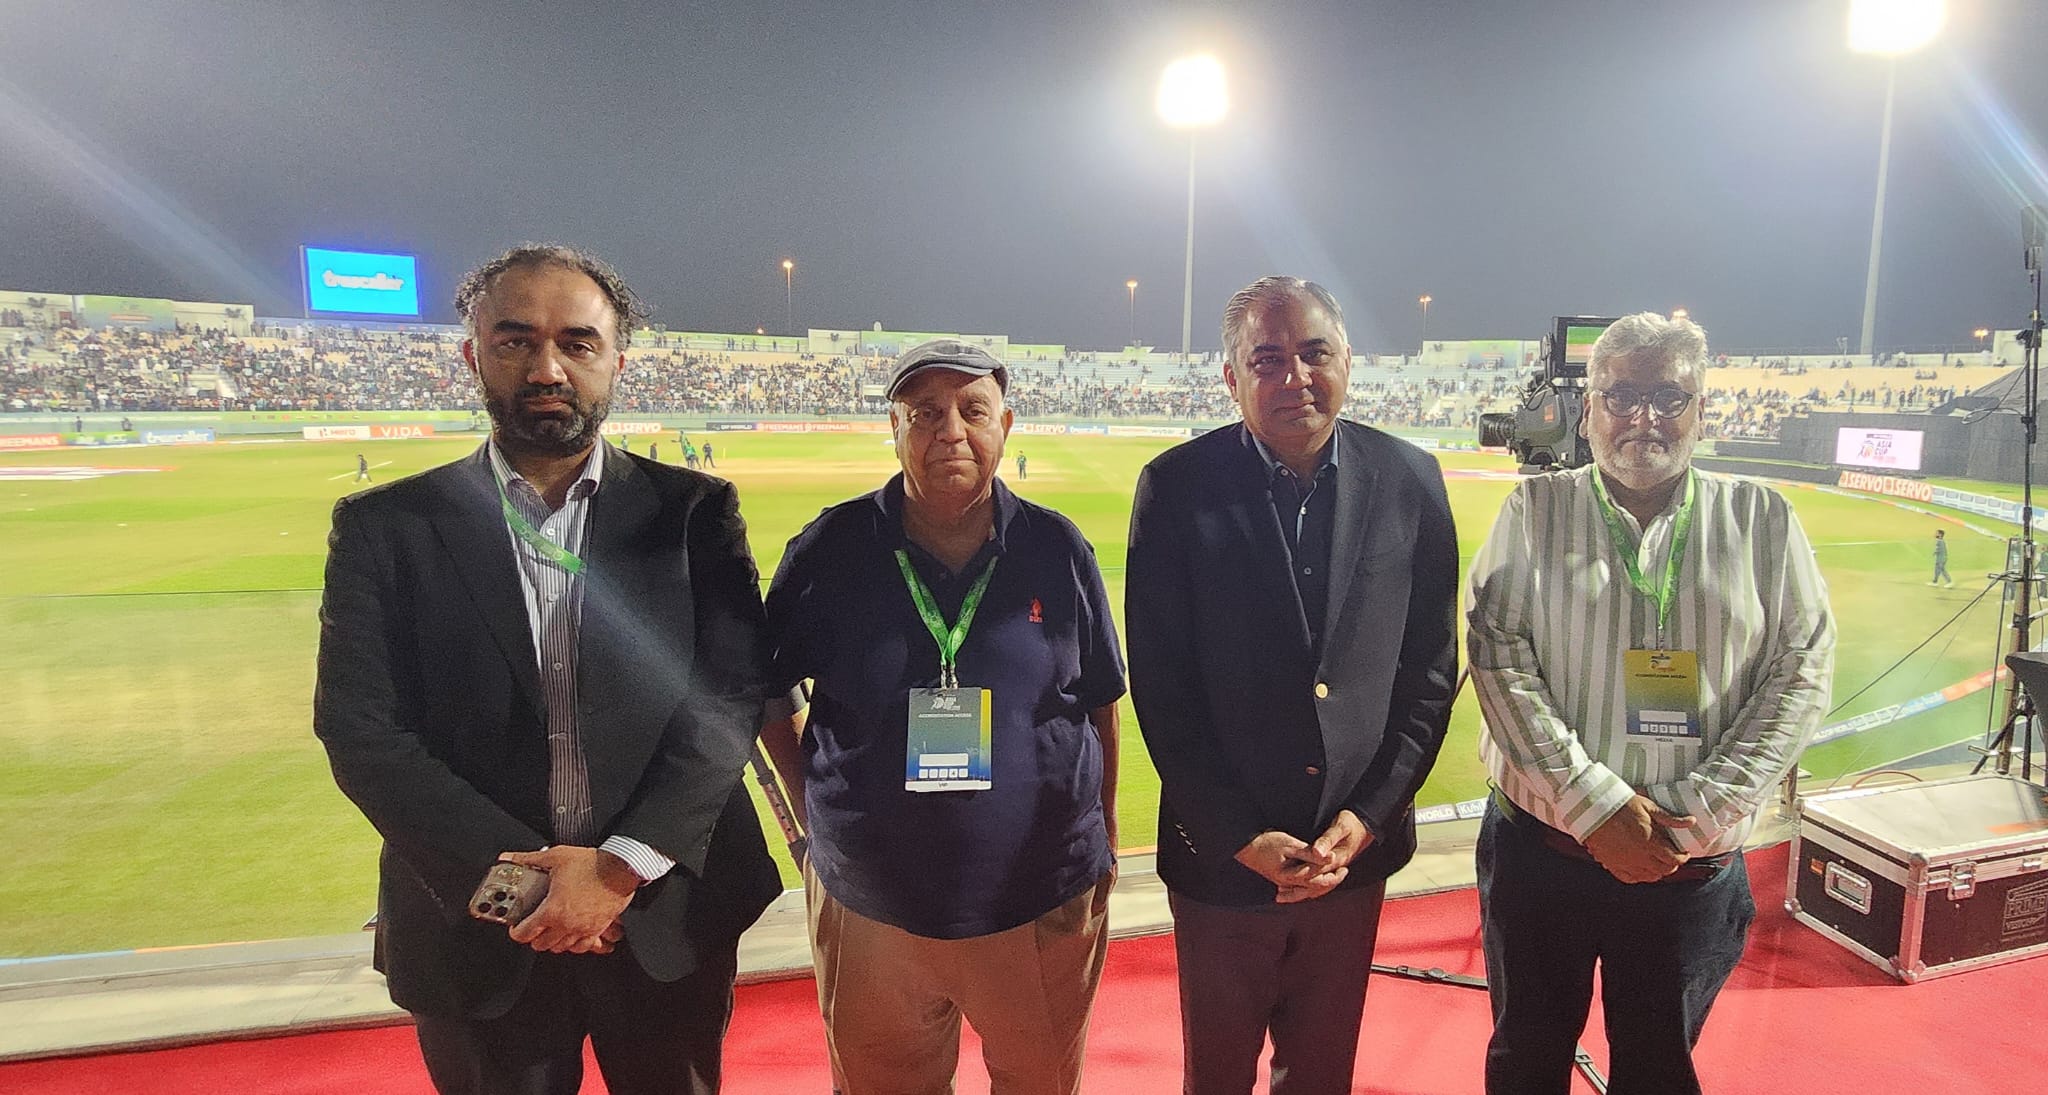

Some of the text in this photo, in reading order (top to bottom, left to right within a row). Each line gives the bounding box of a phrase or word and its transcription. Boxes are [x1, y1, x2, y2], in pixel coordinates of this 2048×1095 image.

[381, 426, 423, 437] VIDA
[623, 422, 661, 433] SERVO
[1034, 424, 1066, 433] SERVO
[1876, 440, 1892, 448] ASIA
[1874, 447, 1889, 456] CUP
[1848, 471, 1883, 493] SERVO
[1894, 479, 1932, 502] SERVO
[1415, 807, 1453, 822] WORLD
[2006, 895, 2046, 918] PRIME
